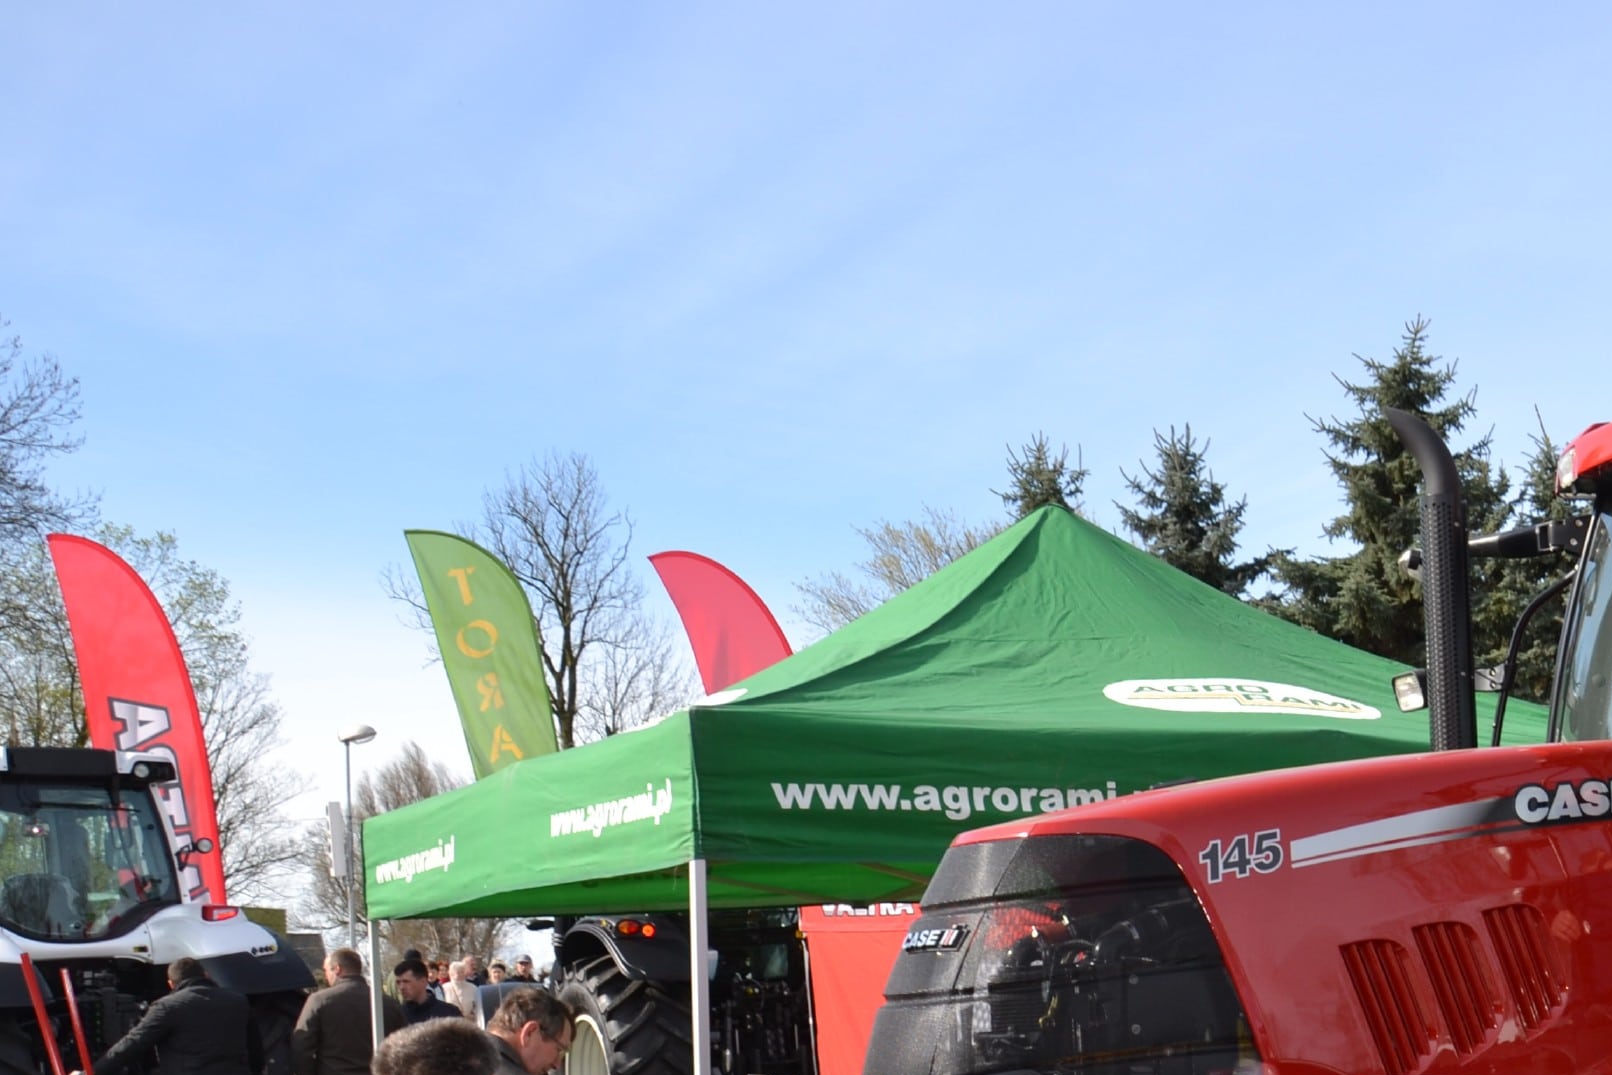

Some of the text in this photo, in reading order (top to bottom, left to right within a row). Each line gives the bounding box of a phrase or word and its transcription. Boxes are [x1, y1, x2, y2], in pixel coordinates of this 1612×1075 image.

[1133, 683, 1271, 694] AGRO
[1243, 693, 1362, 712] RAMI
[550, 777, 673, 838] www.agrorami.pl
[770, 780, 1153, 820] www.agrorami
[375, 834, 456, 884] www.agrorami.pl
[1198, 827, 1284, 885] 145
[903, 930, 940, 949] CASE
